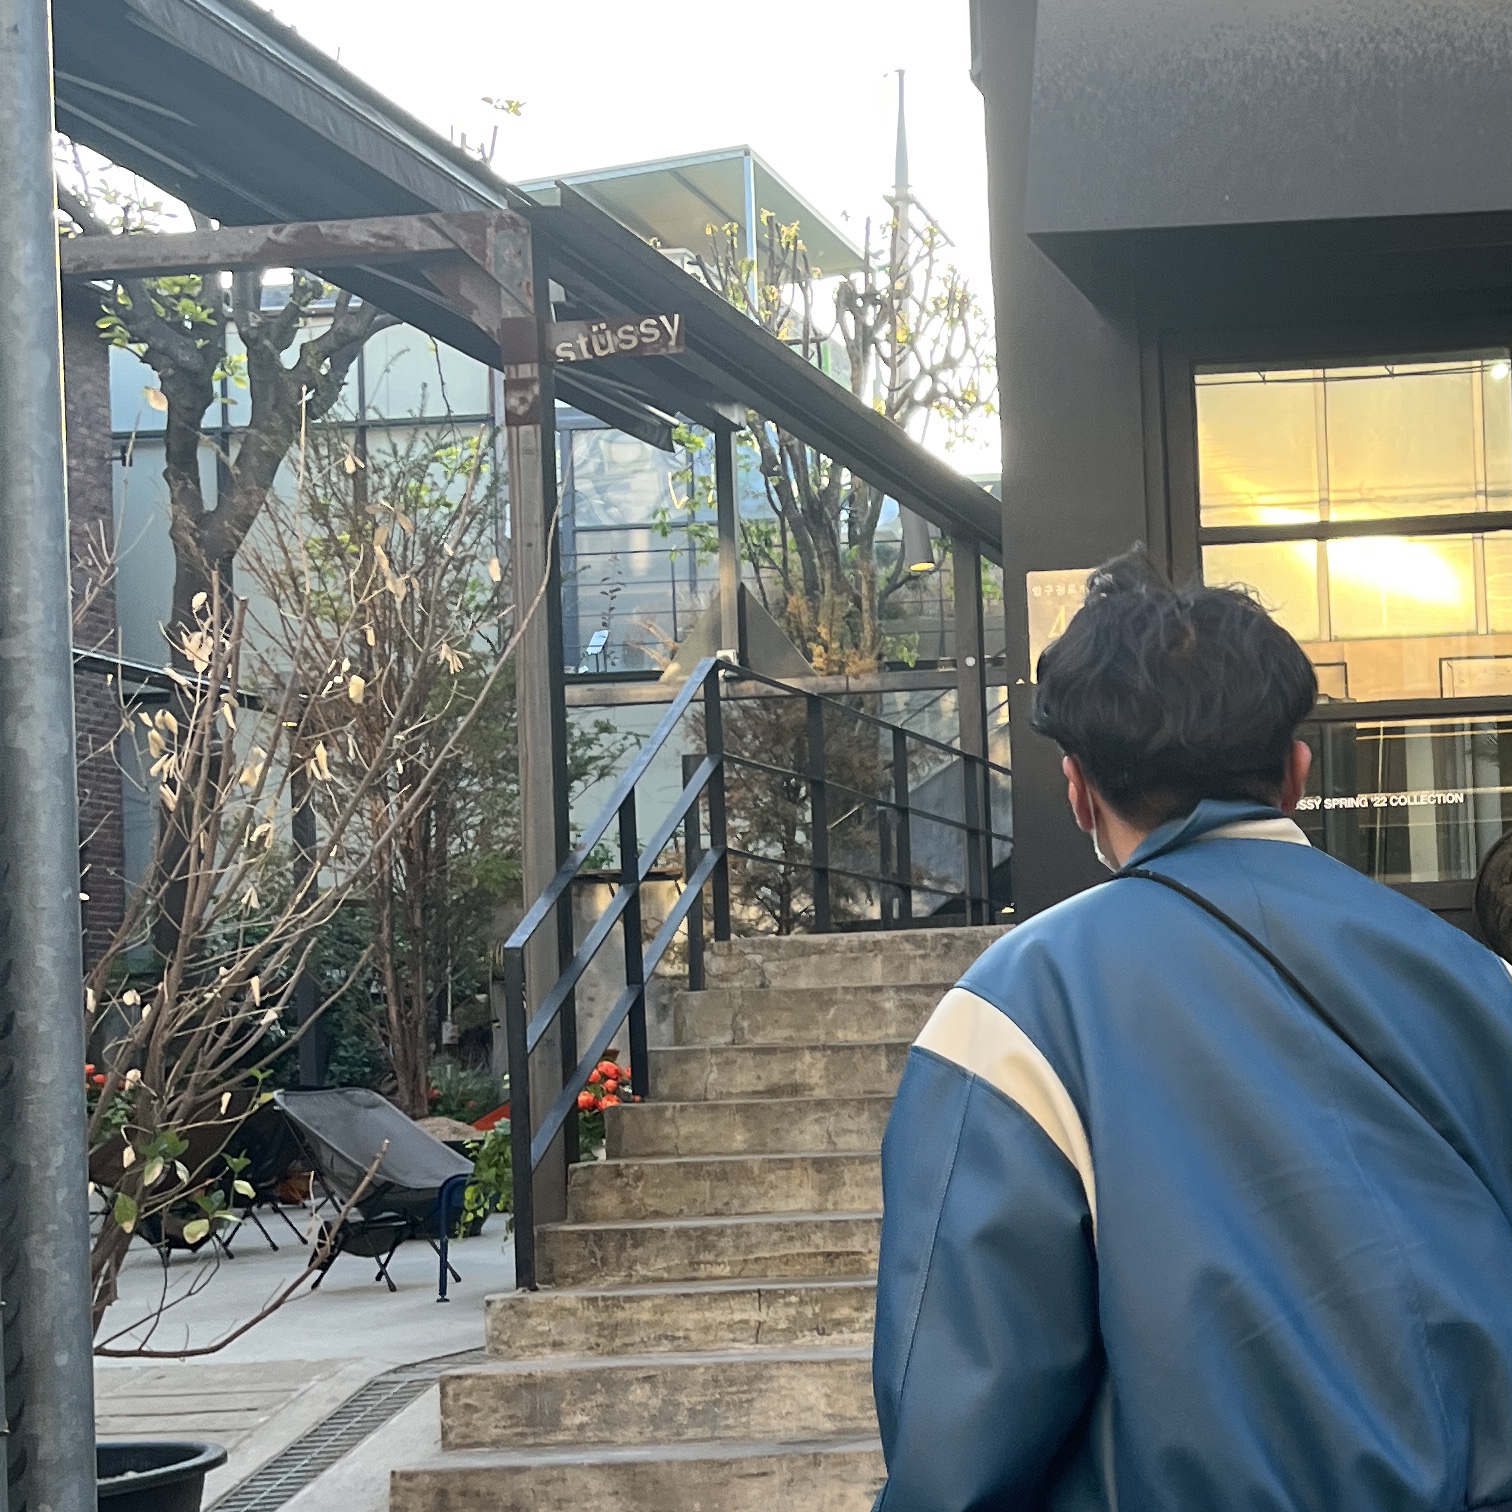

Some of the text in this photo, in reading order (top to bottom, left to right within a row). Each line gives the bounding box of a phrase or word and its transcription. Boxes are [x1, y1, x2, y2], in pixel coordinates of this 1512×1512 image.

[555, 313, 680, 363] stüssy
[1323, 796, 1369, 810] SPRING
[1371, 796, 1388, 808] '22
[1389, 792, 1465, 807] COLLECTION
